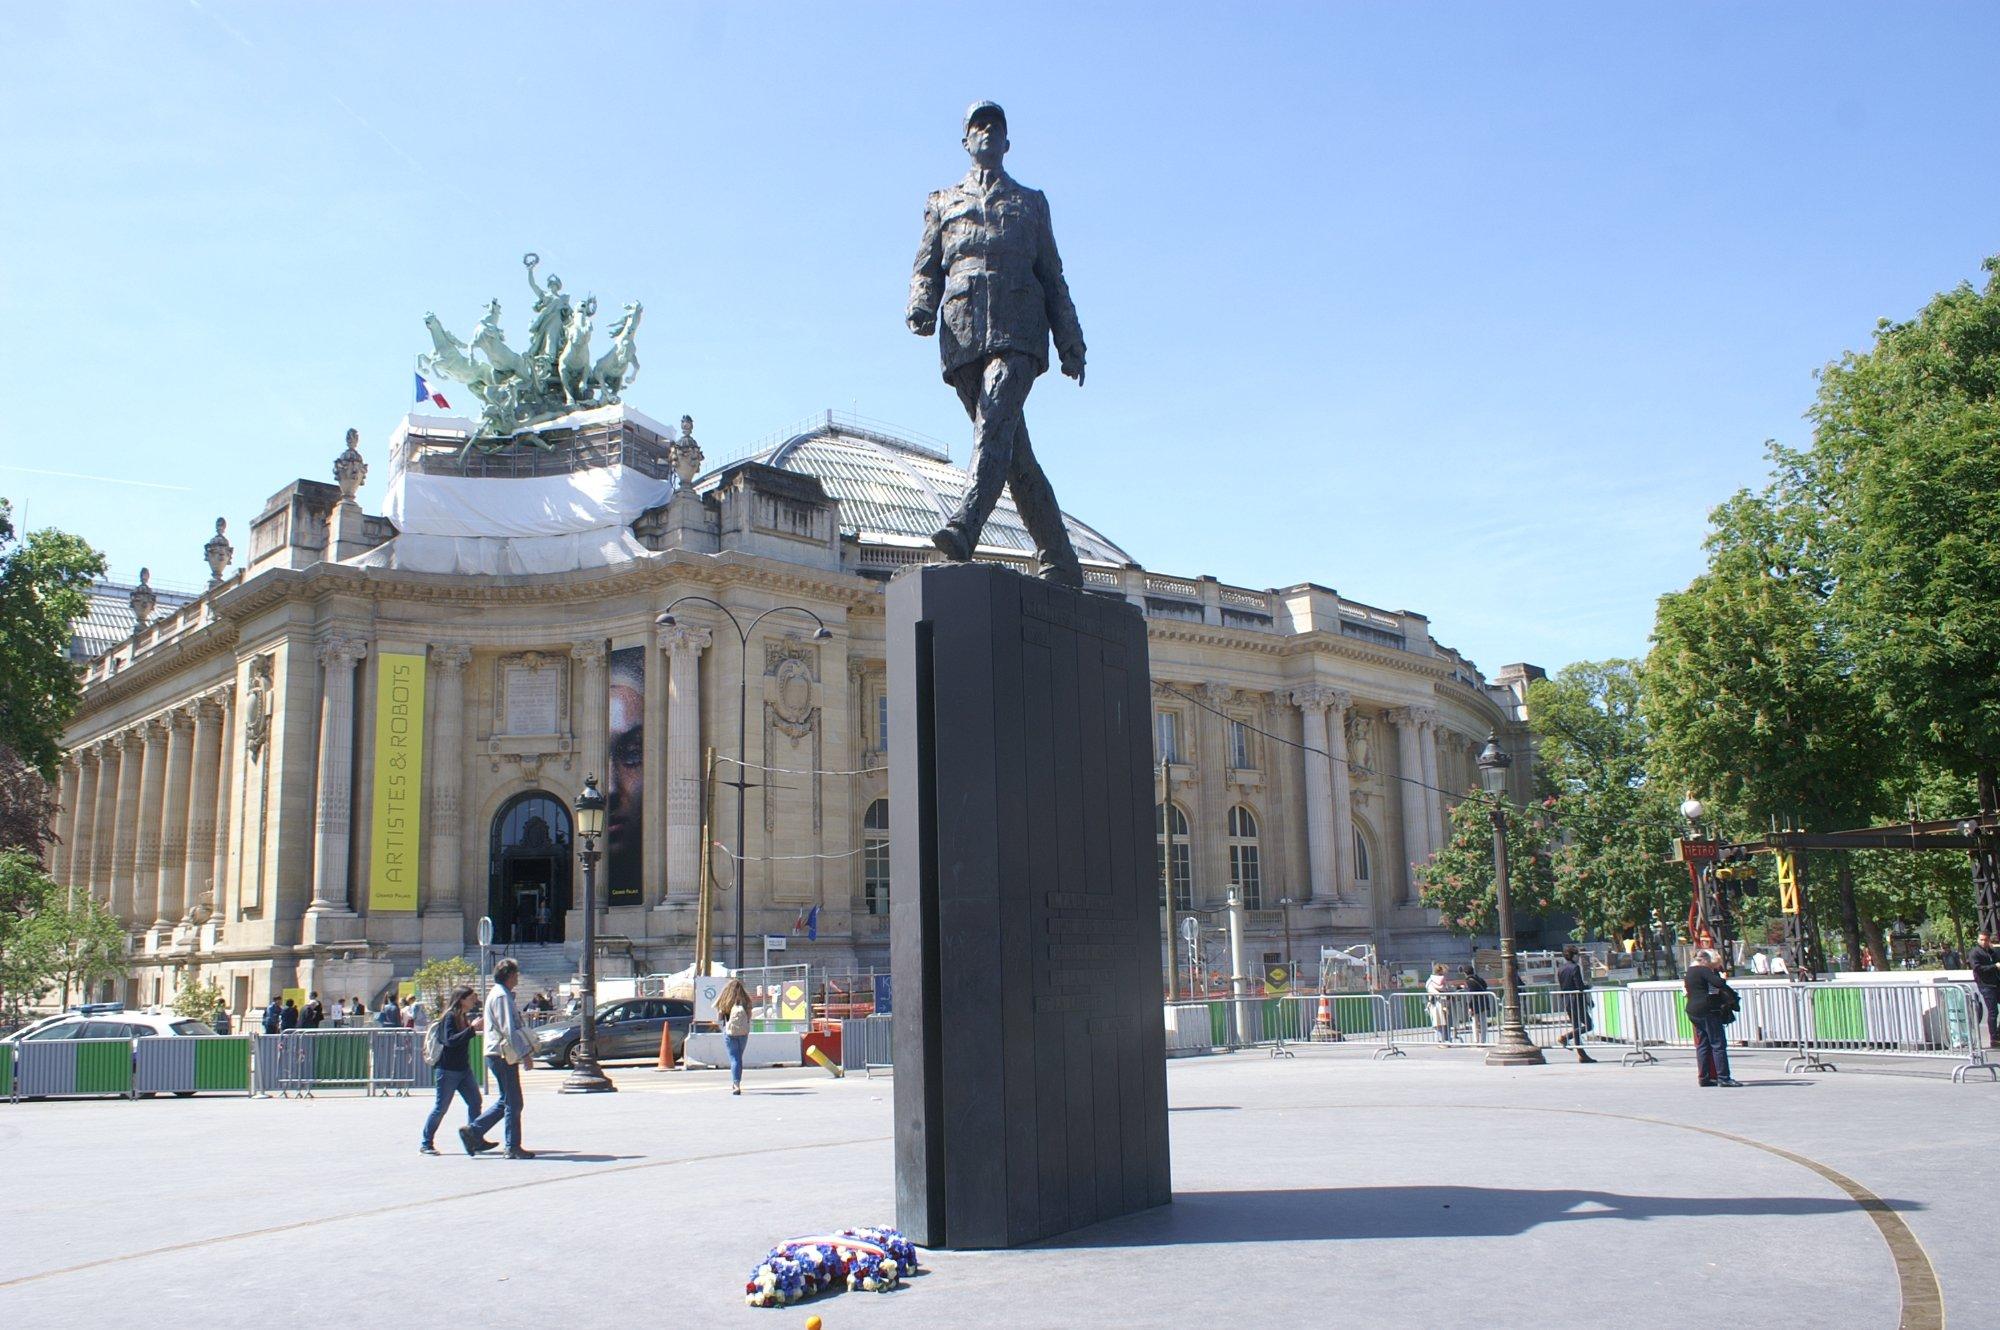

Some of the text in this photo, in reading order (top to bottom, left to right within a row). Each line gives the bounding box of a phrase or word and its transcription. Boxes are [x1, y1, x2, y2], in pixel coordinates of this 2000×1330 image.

[385, 665, 410, 883] ARTISTES & ROBOTS
